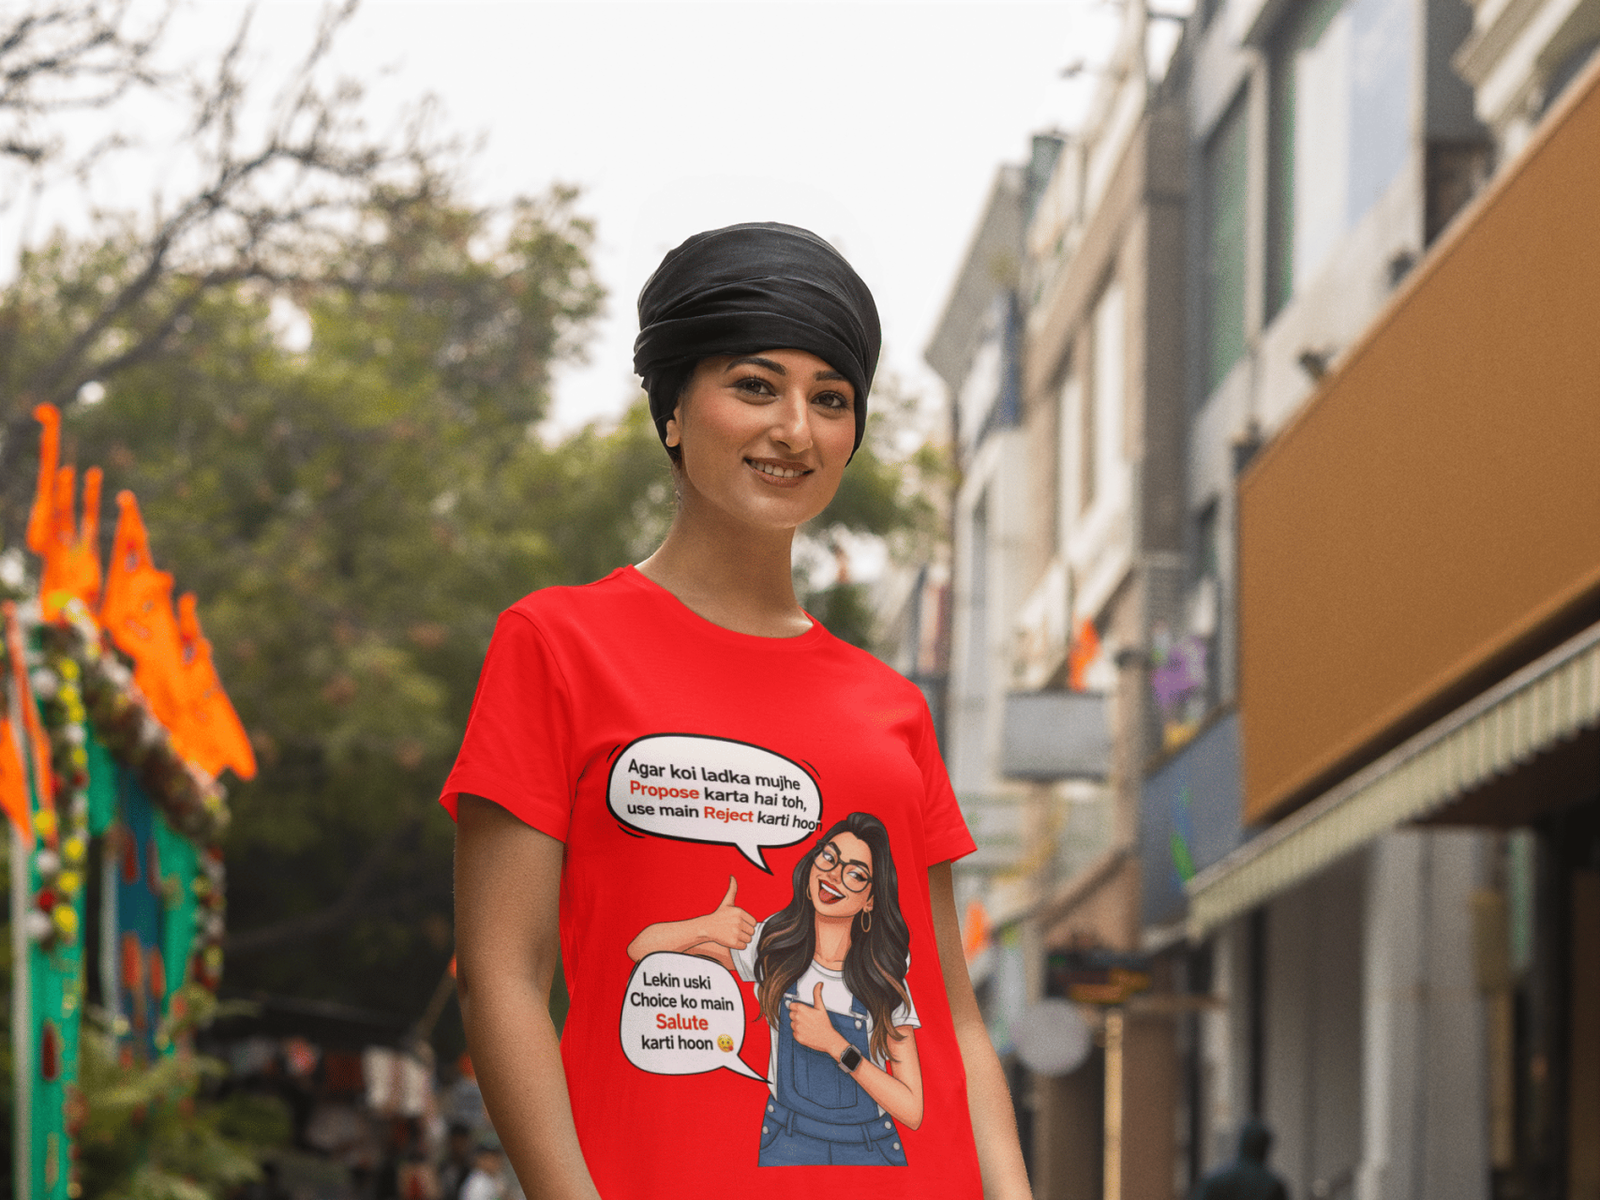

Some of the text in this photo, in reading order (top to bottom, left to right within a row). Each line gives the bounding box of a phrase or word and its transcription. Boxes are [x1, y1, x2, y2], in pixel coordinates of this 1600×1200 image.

[628, 759, 800, 791] Agar koi ladka mujhe
[630, 780, 806, 812] Propose karta hai toh,
[627, 804, 823, 832] use main Reject karti hoon
[643, 972, 711, 989] Lekin uski
[630, 992, 734, 1011] Choice ko main
[656, 1013, 708, 1030] Salute
[642, 1035, 713, 1050] karti hoon
